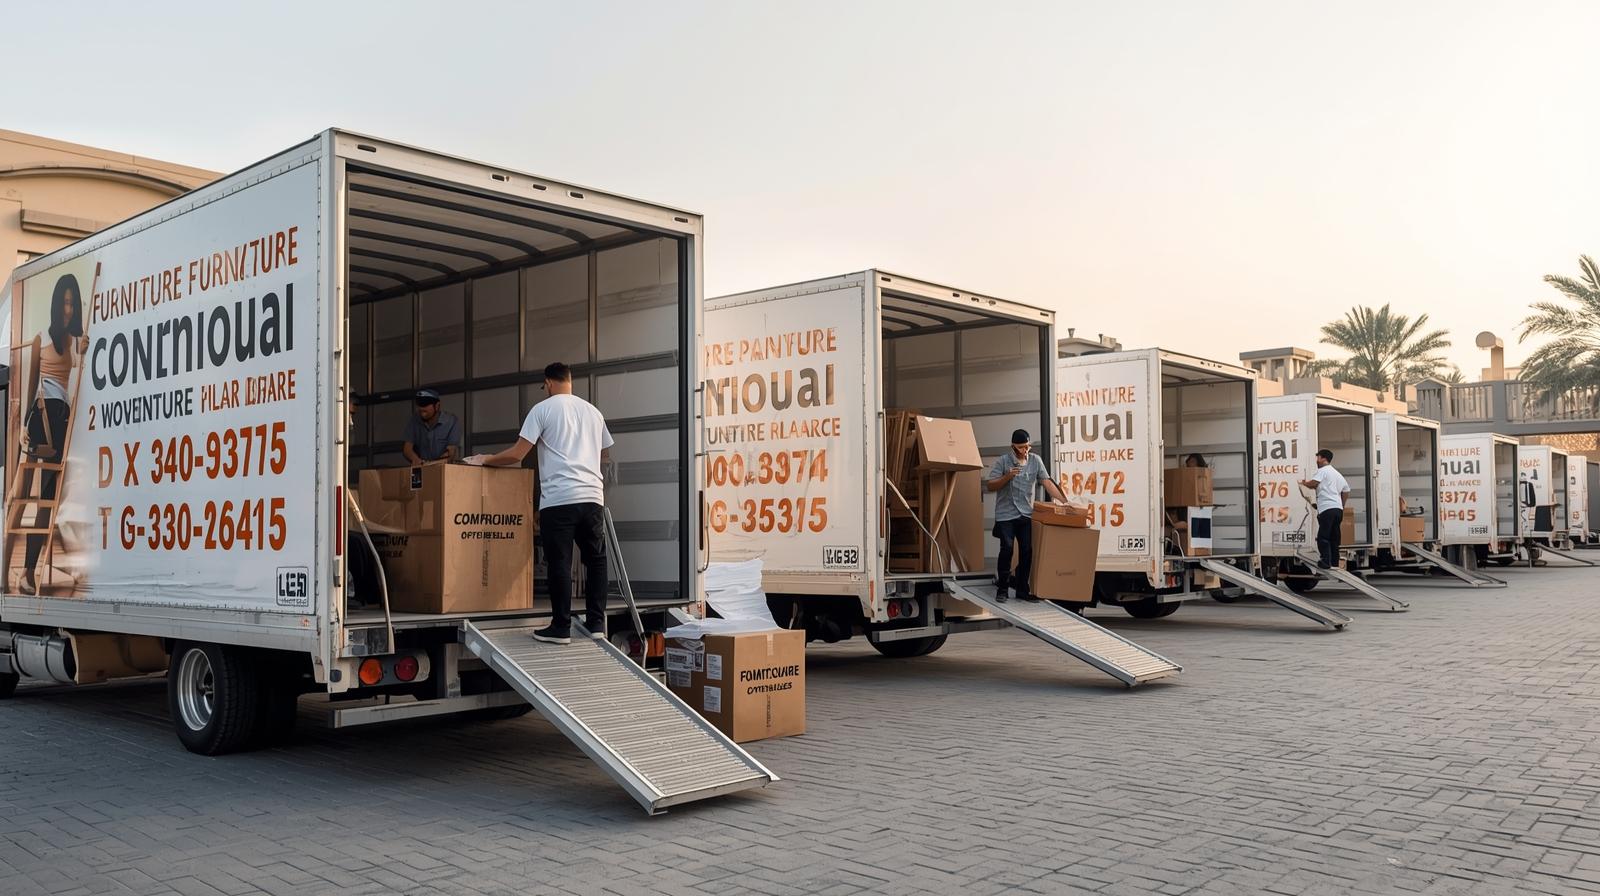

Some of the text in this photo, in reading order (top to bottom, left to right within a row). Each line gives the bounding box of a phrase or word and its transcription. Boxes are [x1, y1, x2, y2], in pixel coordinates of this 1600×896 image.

[93, 266, 182, 324] FURNITURE
[88, 405, 96, 431] 2
[98, 421, 287, 488] D X 340-93775
[98, 497, 287, 551] T G-330-26415
